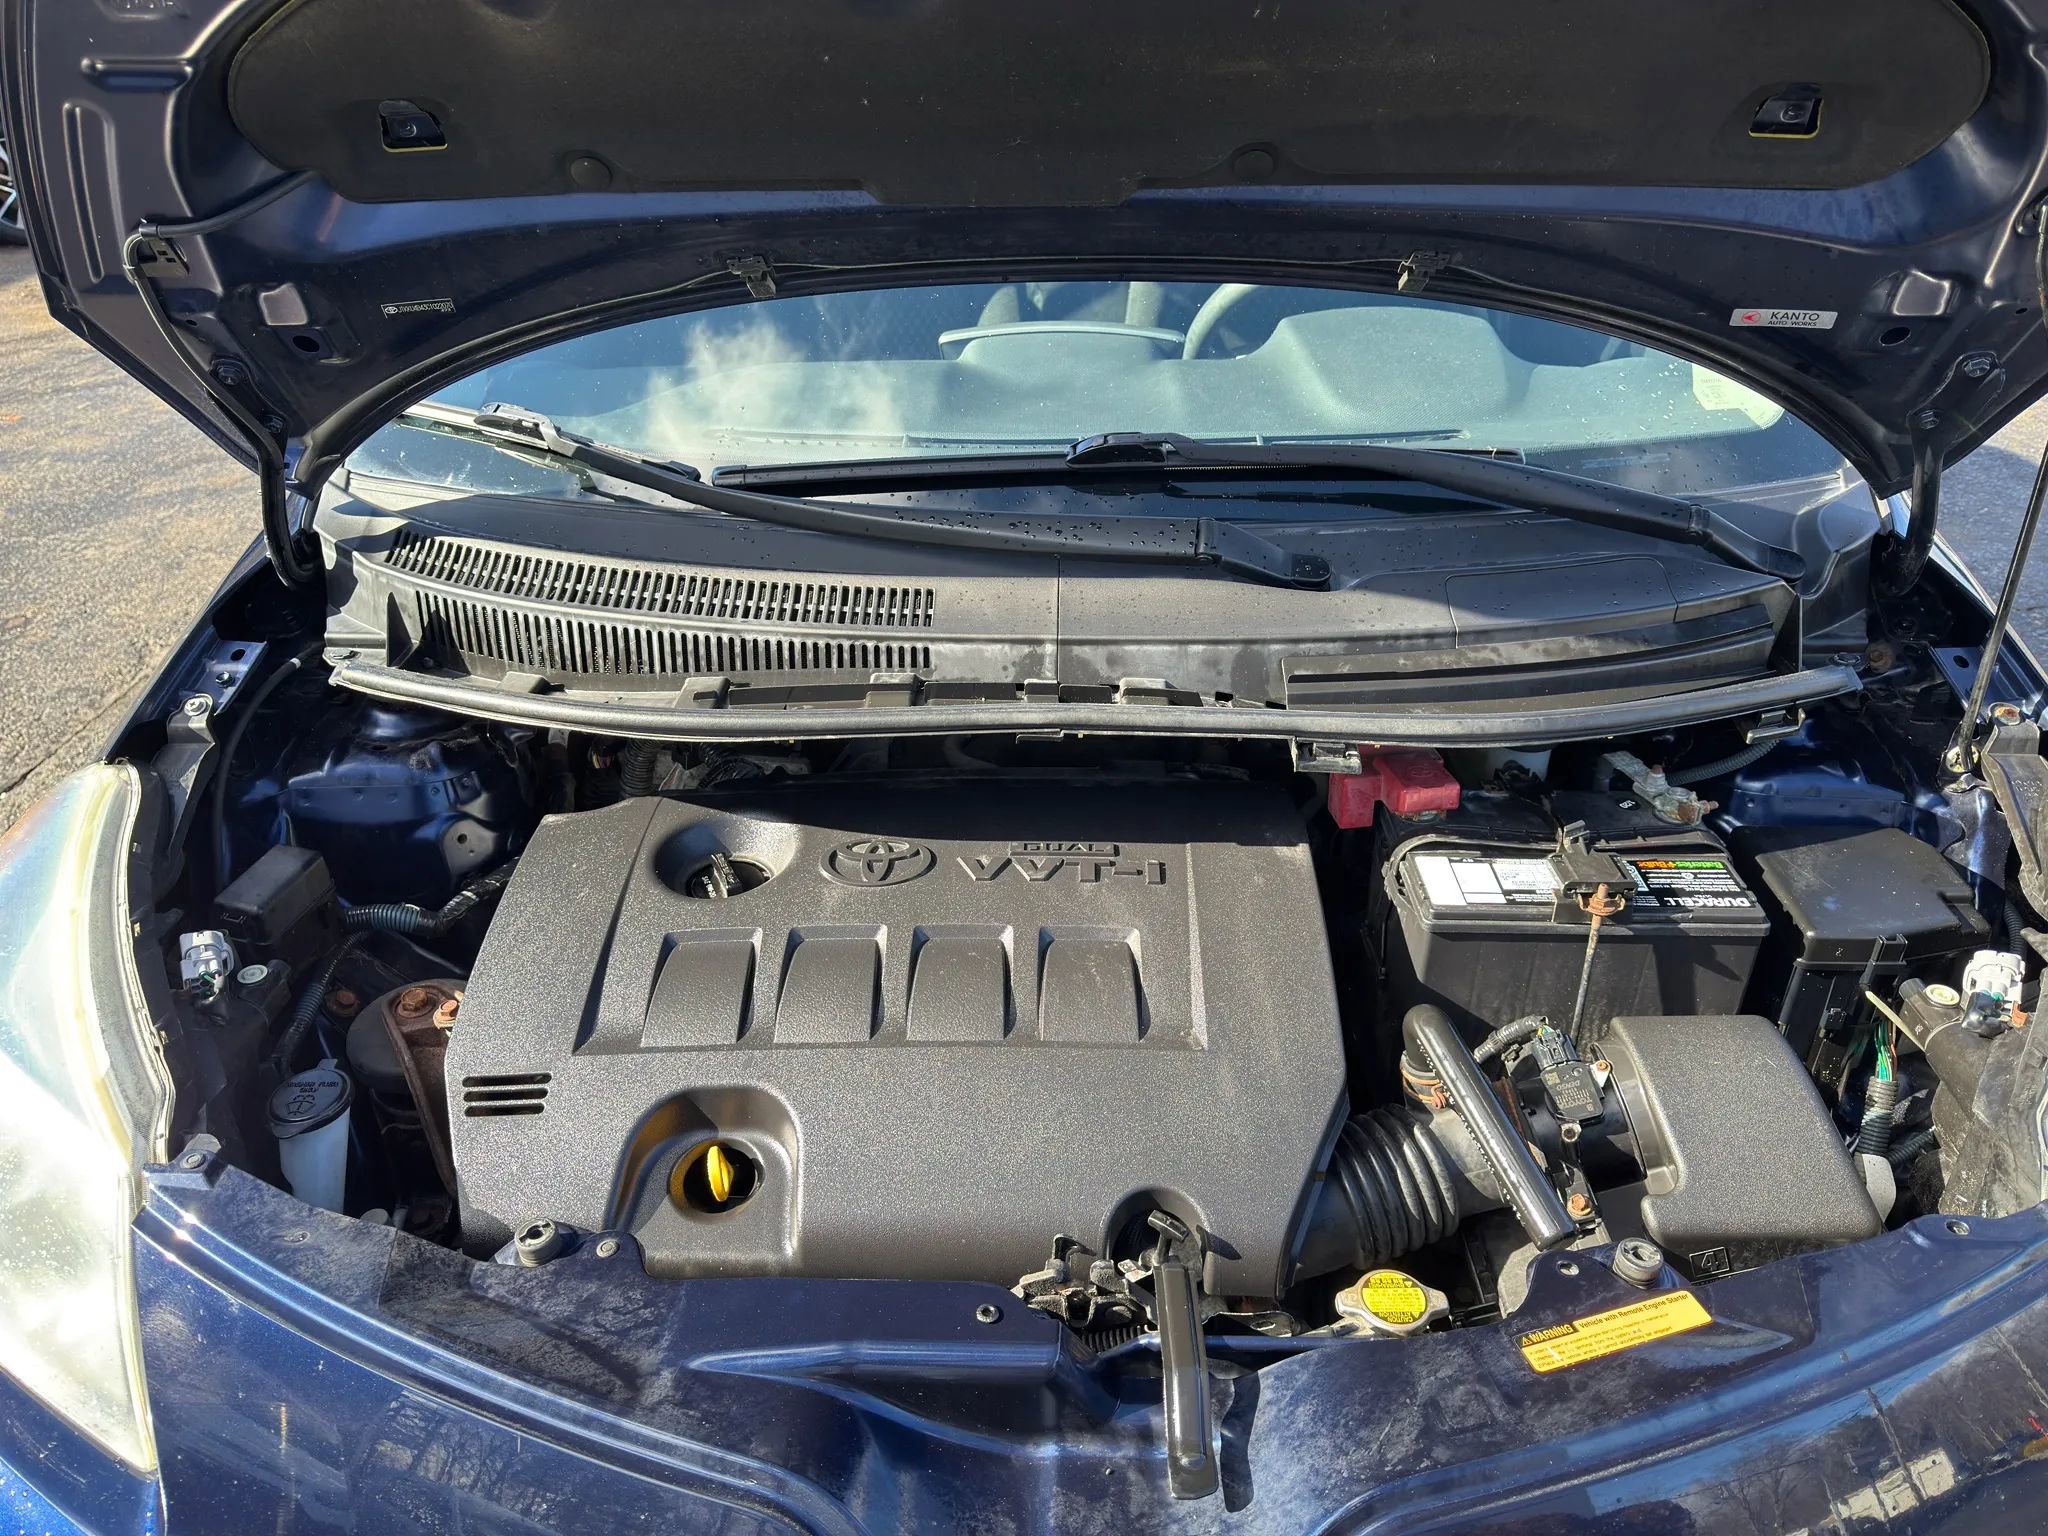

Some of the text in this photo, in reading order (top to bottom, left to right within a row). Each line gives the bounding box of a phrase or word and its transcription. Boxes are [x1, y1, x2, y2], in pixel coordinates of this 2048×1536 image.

[1770, 311, 1820, 321] KANTO
[1023, 842, 1105, 852] DUAL
[1664, 897, 1751, 907] DURACELL
[1556, 1080, 1580, 1090] DENSO
[1557, 1097, 1592, 1109] TOYOTA
[1529, 1293, 1690, 1343] WARNING Vehicle with Remote Engine Starter
